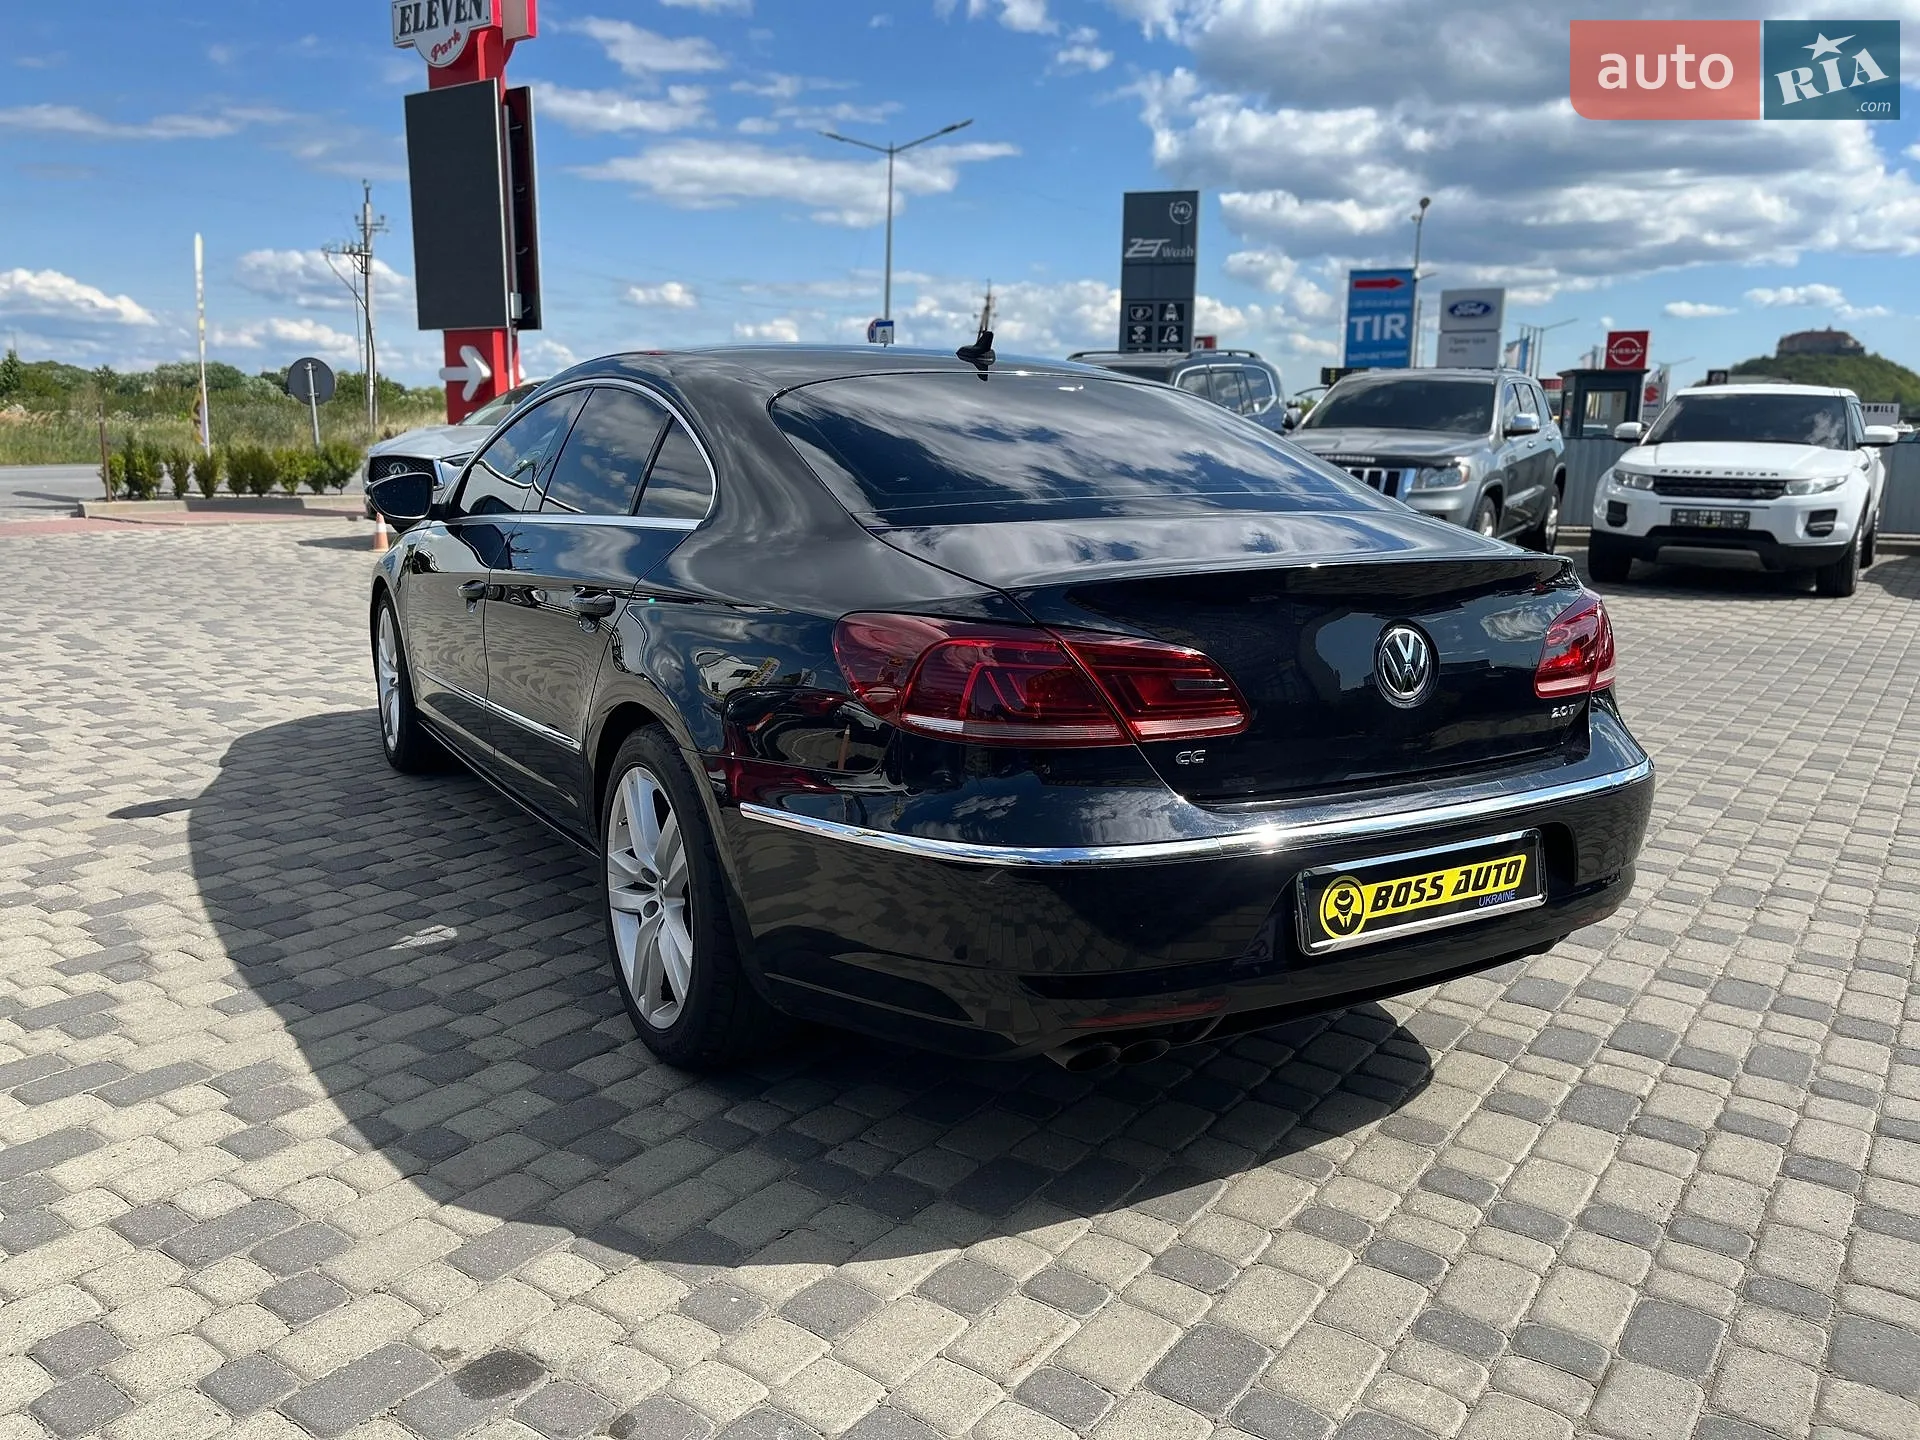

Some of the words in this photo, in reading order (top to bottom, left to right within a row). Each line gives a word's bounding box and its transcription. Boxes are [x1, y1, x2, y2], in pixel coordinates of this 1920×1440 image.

[399, 0, 483, 36] ELEVEN
[431, 28, 461, 62] Park
[1350, 313, 1407, 341] TIR
[1369, 874, 1445, 913] BOSS
[1451, 858, 1523, 897] AUTO
[1478, 888, 1516, 907] UKRAINE
